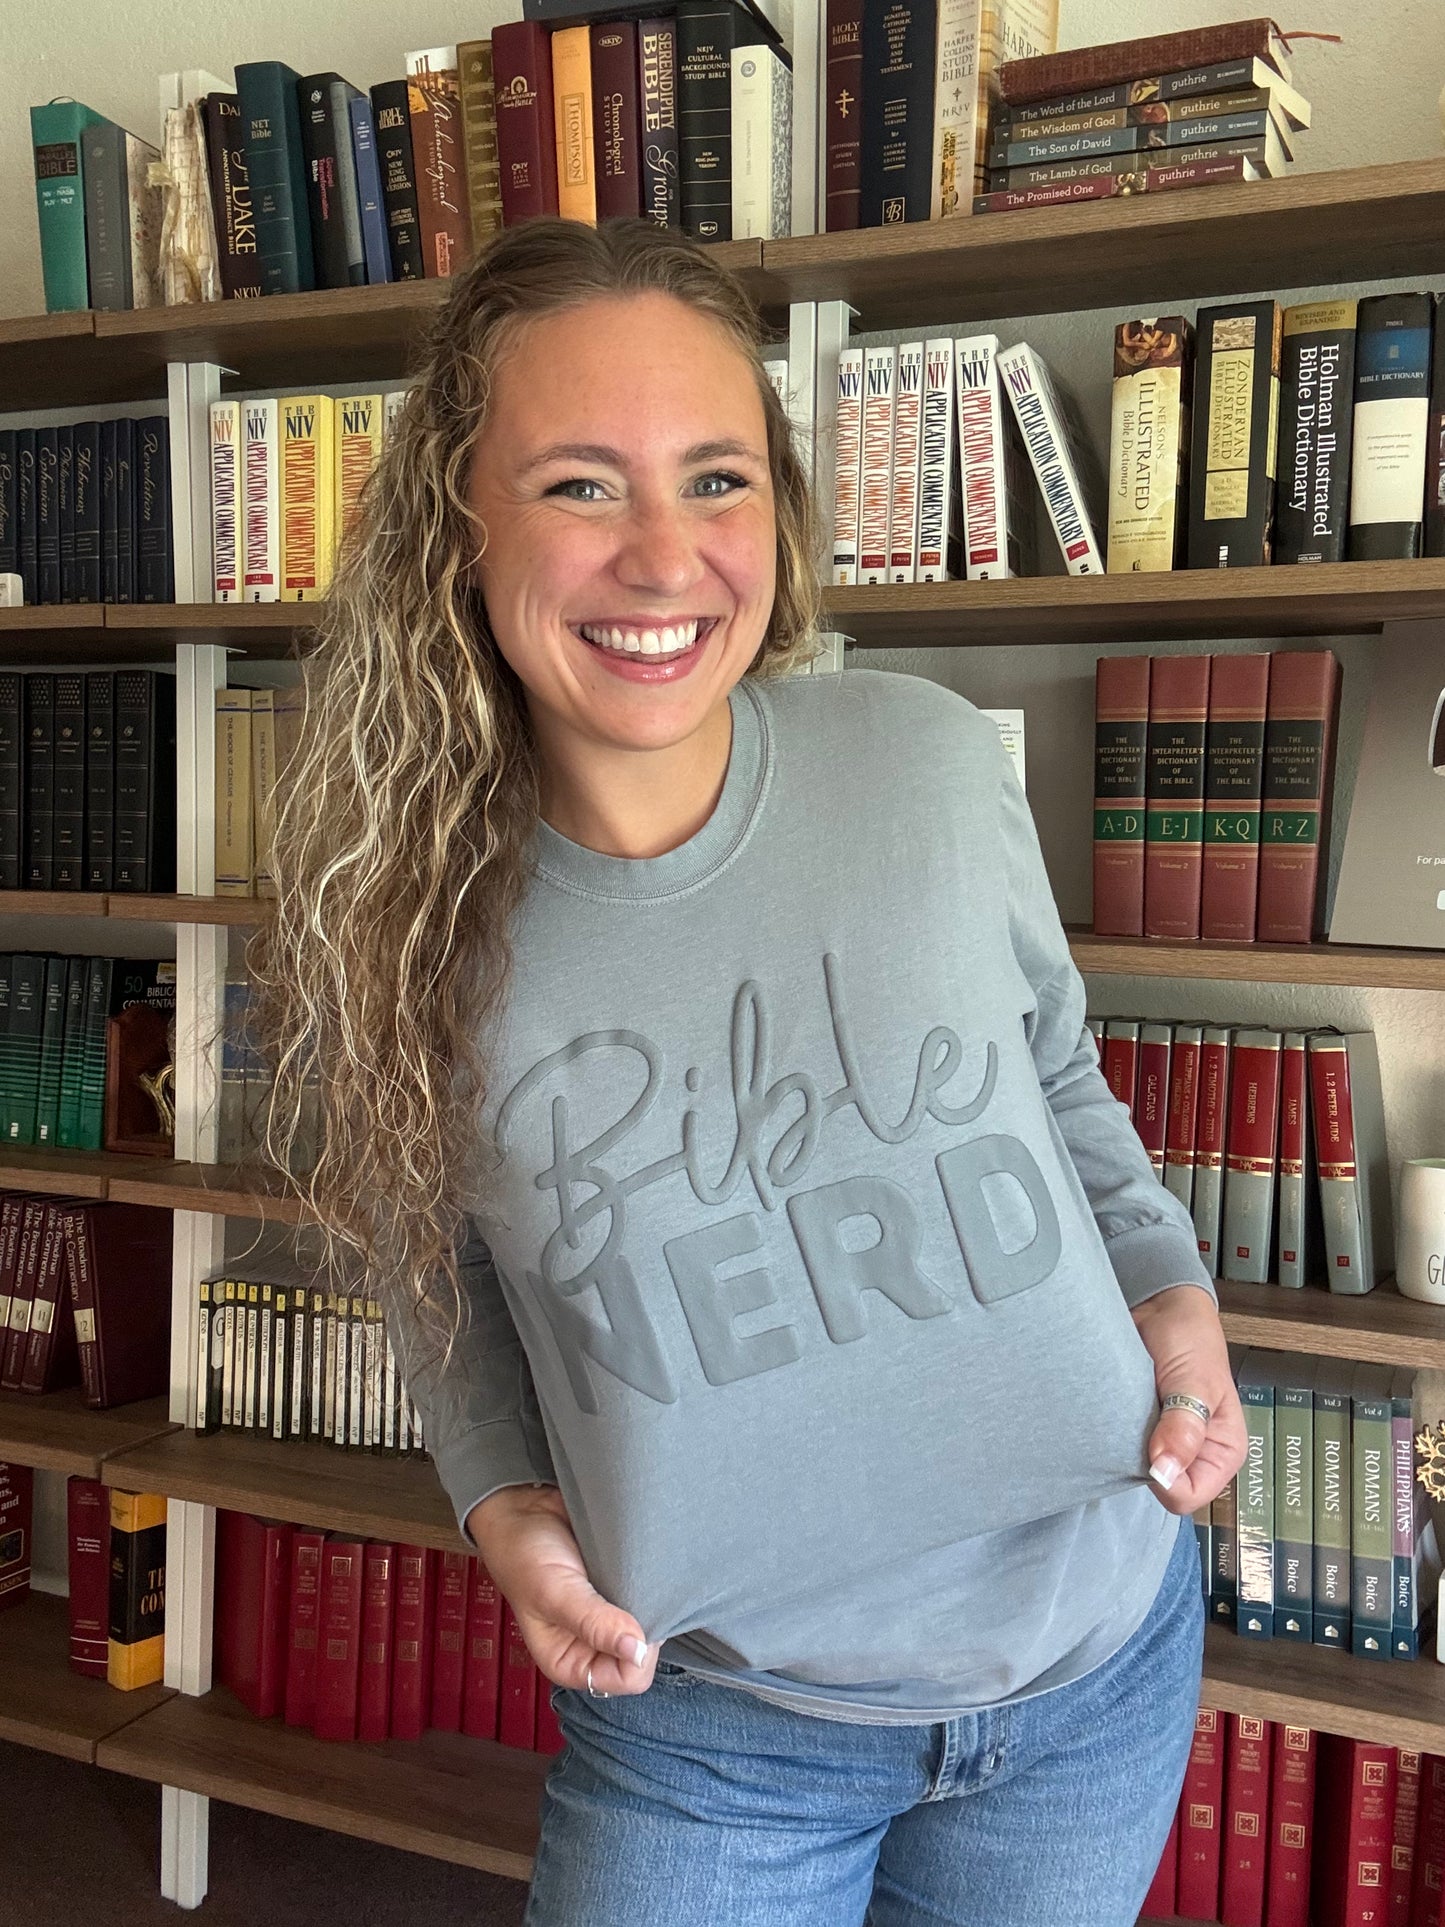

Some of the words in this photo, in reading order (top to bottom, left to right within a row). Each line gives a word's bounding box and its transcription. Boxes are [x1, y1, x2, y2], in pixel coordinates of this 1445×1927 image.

[832, 21, 860, 36] HOLY
[832, 32, 860, 45] BIBLE
[944, 33, 976, 48] HARPER
[688, 54, 723, 62] CULTURAL
[697, 45, 714, 53] NKJV
[943, 44, 975, 58] COLLINS
[943, 57, 974, 70] STUDY
[643, 34, 660, 133] BIBLE
[658, 32, 675, 130] SERENDIPITY
[682, 63, 731, 71] BACKGROUNDS
[708, 71, 727, 79] BIBLE
[880, 62, 913, 75] TESTAMENT
[942, 64, 974, 82] BIBLE
[1171, 74, 1207, 91] guthrie
[379, 107, 401, 121] HOLY
[1021, 110, 1039, 121] The
[1040, 103, 1064, 117] Word
[1066, 100, 1075, 111] of
[1077, 98, 1092, 110] the
[1094, 92, 1115, 106] Lord
[1180, 100, 1220, 116] guthrie
[251, 119, 270, 129] NET
[252, 129, 271, 139] Bible
[568, 101, 582, 180] THOMPSON
[611, 92, 625, 176] Chronological
[1021, 127, 1039, 138] The
[1041, 120, 1081, 135] Wisdom
[1083, 117, 1093, 129] of
[1095, 114, 1116, 128] God
[1181, 123, 1218, 138] guthrie
[425, 99, 459, 214] Archaeological
[1029, 145, 1047, 157] The
[1050, 143, 1068, 154] Son
[1070, 140, 1080, 152] of
[1082, 136, 1112, 150] David
[1181, 149, 1218, 164] guthrie
[39, 160, 76, 176] BIBLE
[1029, 171, 1048, 183] The
[1050, 166, 1077, 180] Lamb
[1079, 164, 1089, 176] of
[1091, 162, 1112, 174] God
[1158, 168, 1196, 184] guthrie
[1006, 193, 1025, 205] The
[1027, 184, 1071, 202] Promised
[1073, 184, 1094, 196] One
[1328, 309, 1346, 317] AND
[960, 348, 989, 363] THE
[839, 373, 861, 397] NIV
[868, 369, 892, 395] NIV
[900, 365, 920, 391] NIV
[928, 362, 949, 389] NIV
[962, 360, 989, 390] NIV
[1008, 365, 1032, 398] NIV
[1215, 361, 1225, 392] BIBLE
[1298, 347, 1318, 399] Bible
[1318, 345, 1339, 428] Holman
[1382, 371, 1425, 381] DICTIONARY
[285, 405, 315, 416] THE
[342, 411, 372, 434] NIV
[1122, 410, 1134, 436] Bible
[1222, 361, 1238, 460] ILLUSTRATED
[1234, 359, 1250, 459] ZONDERVAN
[213, 420, 233, 442] NIV
[247, 418, 267, 440] NIV
[286, 415, 315, 439] NIV
[836, 399, 859, 466] APPLICATION
[864, 397, 891, 470] APPLICATION
[895, 393, 919, 467] APPLICATION
[924, 391, 947, 466] APPLICATION
[961, 389, 994, 466] APPLICATION
[1212, 395, 1223, 459] DICTIONARY
[1135, 381, 1156, 511] ILLUSTRATED
[1289, 403, 1315, 511] Dictionary
[143, 428, 159, 521] Revelation
[214, 443, 235, 506] APPLICATION
[247, 441, 268, 503] APPLICATION
[285, 440, 316, 504] APPLICATION
[1015, 393, 1059, 468] APPLICATION
[1040, 465, 1085, 545] COMMENTARY
[1118, 440, 1133, 498] Dictionary
[1313, 432, 1336, 536] Illustrated
[834, 470, 857, 542] COMMENTARY
[862, 474, 888, 552] COMMENTARY
[892, 470, 916, 551] COMMENTARY
[921, 469, 944, 550] COMMENTARY
[966, 467, 998, 549] COMMENTARY
[215, 510, 236, 576] COMMENTARY
[247, 505, 268, 571] COMMENTARY
[285, 506, 316, 576] COMMENTARY
[1417, 855, 1432, 865] For
[1146, 1075, 1157, 1121] GALATIANS
[1206, 1072, 1217, 1110] TIMOTHY
[1247, 1082, 1257, 1124] HEBREWS
[496, 953, 999, 1297] Bible
[1288, 1099, 1297, 1126] JAMES
[1205, 1117, 1214, 1142] TITUS
[1330, 1120, 1340, 1143] JUDE
[25, 1207, 33, 1229] Bible
[34, 1210, 44, 1229] The
[63, 1216, 74, 1239] Bible
[75, 1214, 84, 1234] The
[5, 1226, 19, 1270] Broadman
[15, 1232, 31, 1289] Commentary
[27, 1231, 41, 1275] Broadman
[38, 1232, 54, 1289] Commentary
[50, 1231, 63, 1275] Broadman
[77, 1234, 89, 1282] Broadman
[66, 1242, 79, 1302] Commentary
[526, 1133, 1062, 1414] NERD
[15, 1308, 25, 1321] 10
[37, 1310, 47, 1322] 11
[80, 1319, 89, 1332] 12
[1248, 1435, 1264, 1506] ROMANS
[1286, 1435, 1302, 1507] ROMANS
[1325, 1440, 1341, 1512] ROMANS
[1365, 1450, 1381, 1522] ROMANS
[1397, 1440, 1412, 1535] PHILIPPIANS
[1219, 1542, 1230, 1576] Boice
[1287, 1558, 1299, 1593] Boice
[1325, 1564, 1338, 1599] Boice
[1366, 1575, 1378, 1611] Boice
[1400, 1575, 1410, 1608] Boice
[1362, 1911, 1374, 1921] 27
